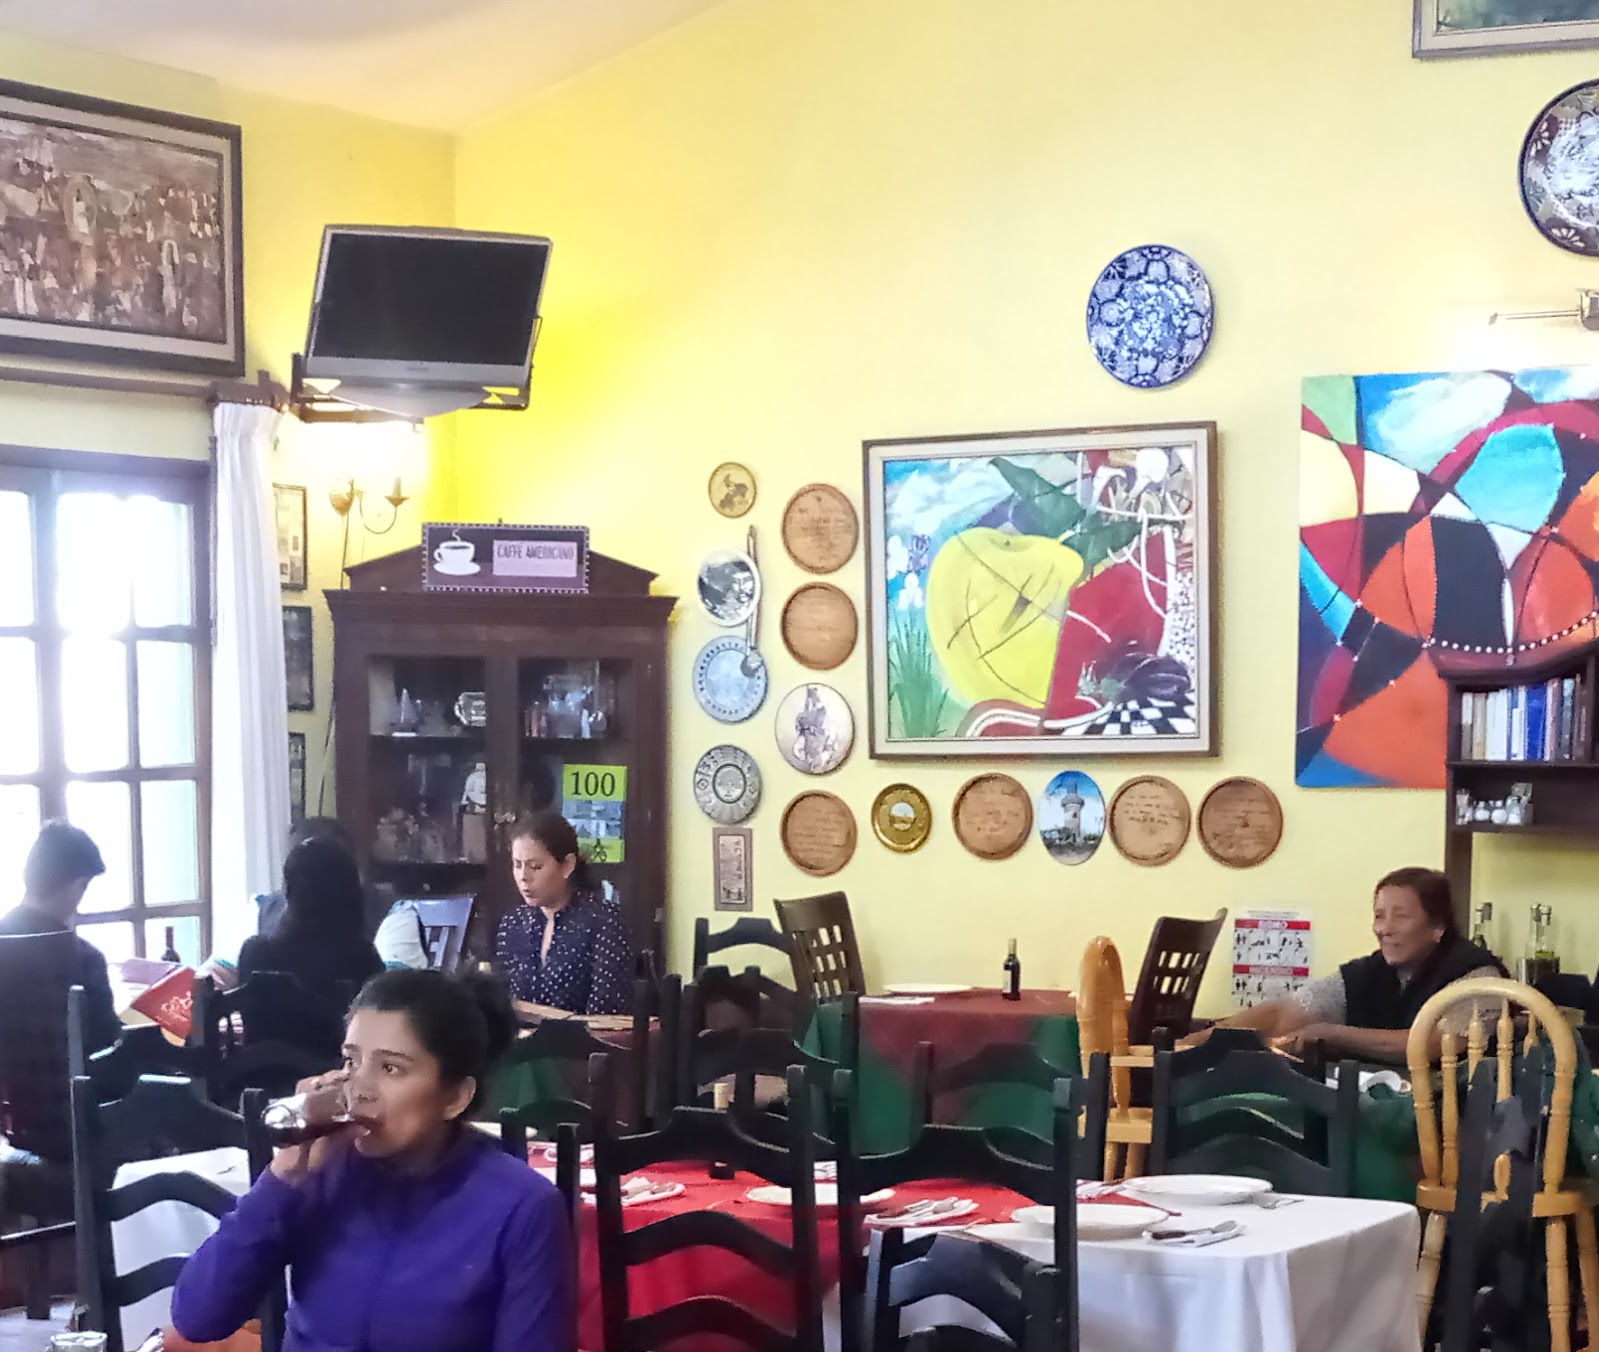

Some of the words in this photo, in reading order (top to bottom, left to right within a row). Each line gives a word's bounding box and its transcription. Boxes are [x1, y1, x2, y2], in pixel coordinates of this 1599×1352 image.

[497, 544, 522, 559] CAFFE
[526, 545, 574, 560] AMERICANO
[571, 771, 616, 797] 100
